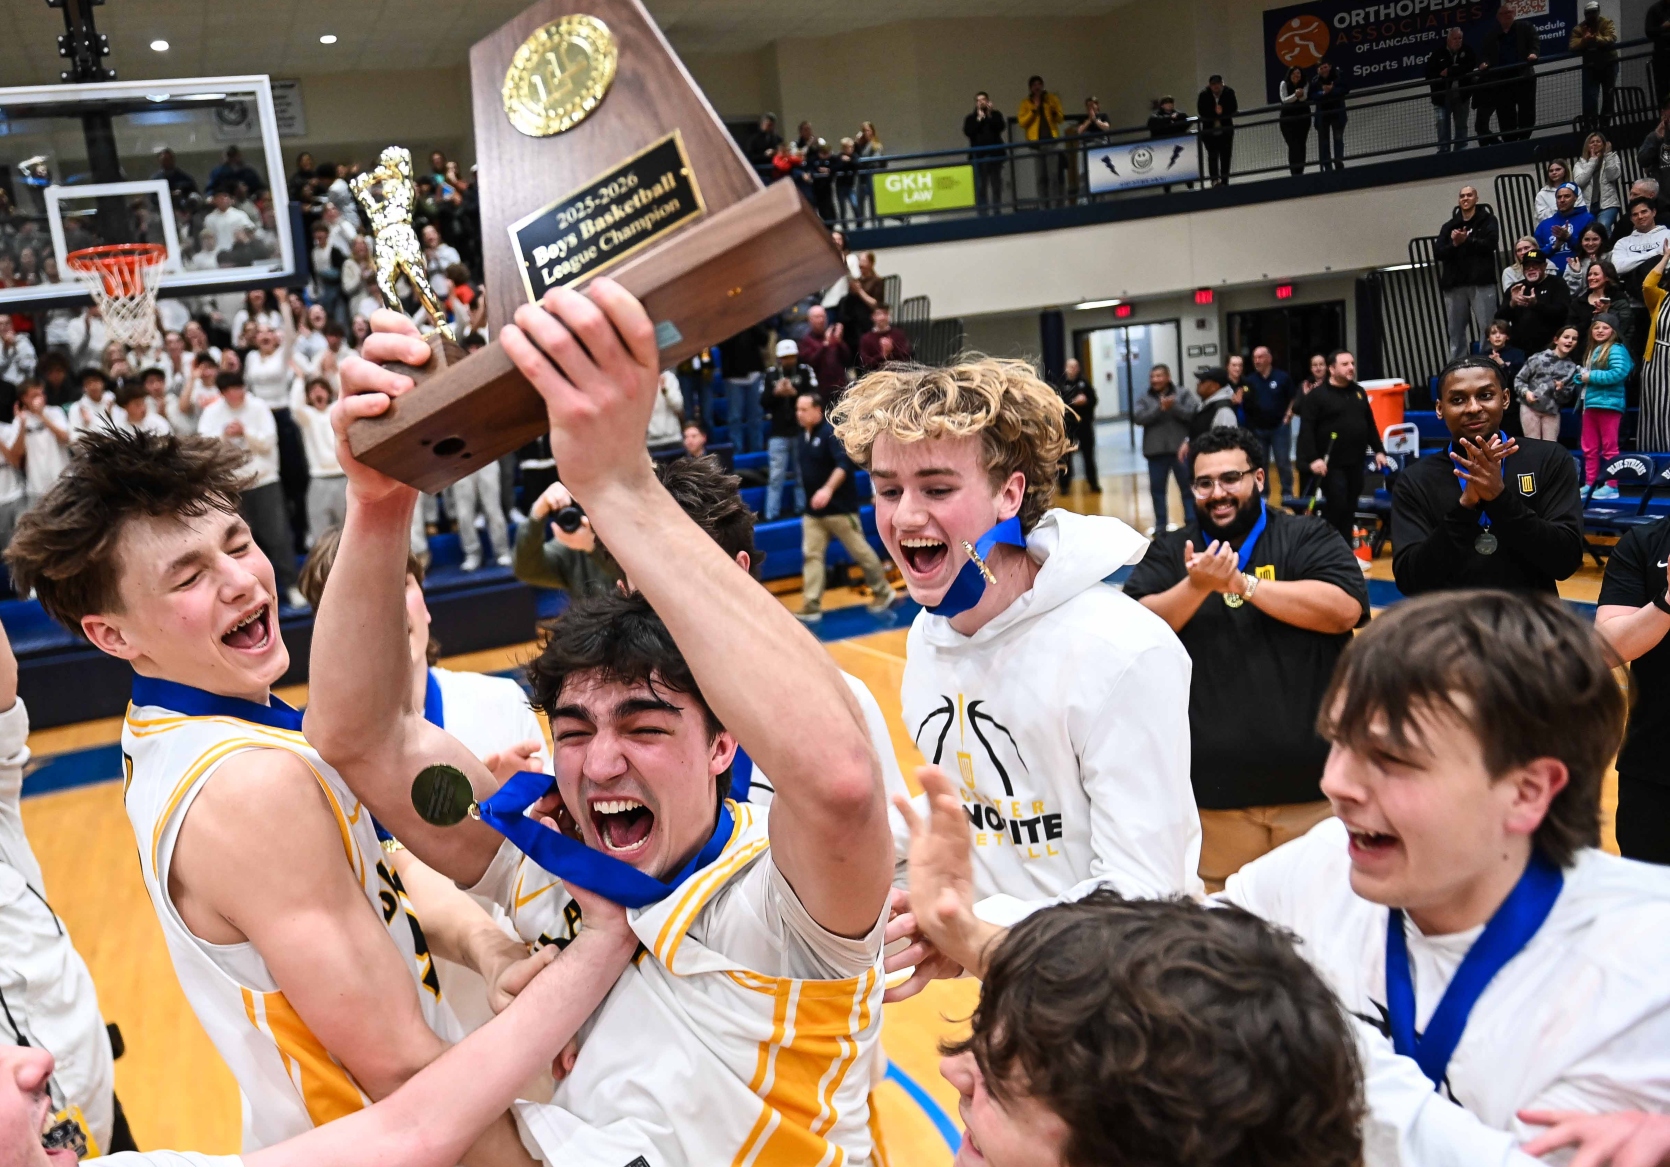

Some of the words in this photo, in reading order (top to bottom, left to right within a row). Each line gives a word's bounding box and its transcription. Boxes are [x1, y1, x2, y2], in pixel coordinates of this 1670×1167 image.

[1336, 5, 1483, 46] ASSOCIATES
[1355, 43, 1371, 54] OF
[1372, 30, 1440, 51] LANCASTER,
[1353, 59, 1399, 78] Sports
[885, 173, 932, 193] GKH
[556, 171, 639, 231] 2025-2026
[903, 189, 933, 204] LAW
[532, 231, 579, 269] Boys
[578, 171, 677, 241] Basketball
[541, 246, 598, 287] League
[599, 197, 681, 251] Champion
[1606, 459, 1624, 476] BLUE
[1623, 458, 1647, 476] STREAKS
